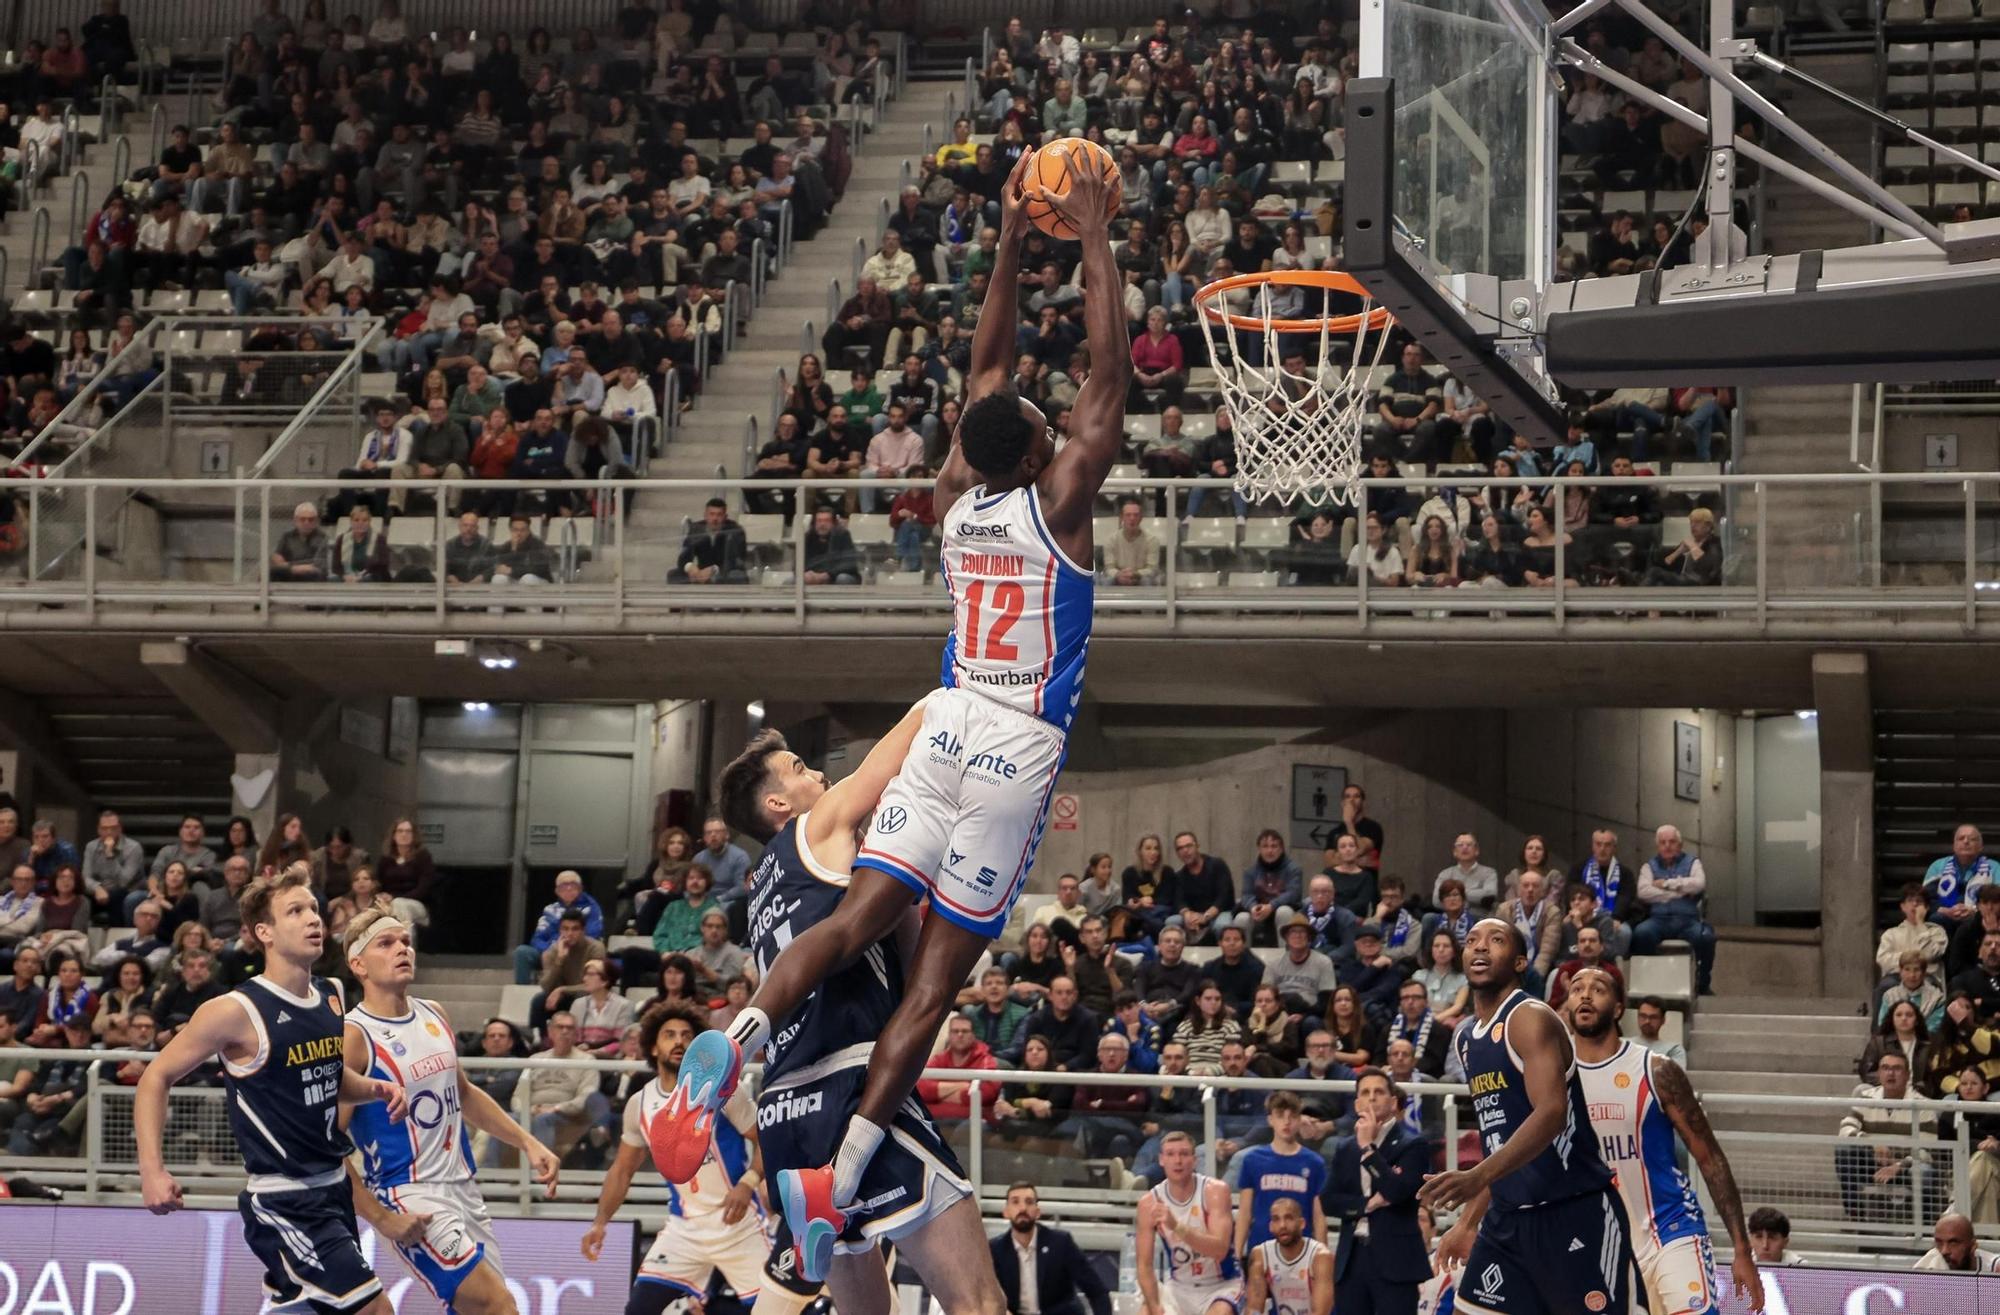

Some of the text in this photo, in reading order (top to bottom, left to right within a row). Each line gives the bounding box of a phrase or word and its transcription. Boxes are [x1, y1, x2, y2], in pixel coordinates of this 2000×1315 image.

[961, 552, 1024, 576] COULIBALY
[962, 579, 1025, 661] 12
[929, 752, 957, 769] Sports
[963, 770, 1001, 787] stination
[965, 881, 994, 897] SEAT
[286, 1036, 344, 1067] ALIMER
[1471, 1071, 1508, 1097] MERKA
[324, 1106, 337, 1141] 7
[1587, 1103, 1625, 1121] ENTUM
[1603, 1134, 1640, 1161] HLA
